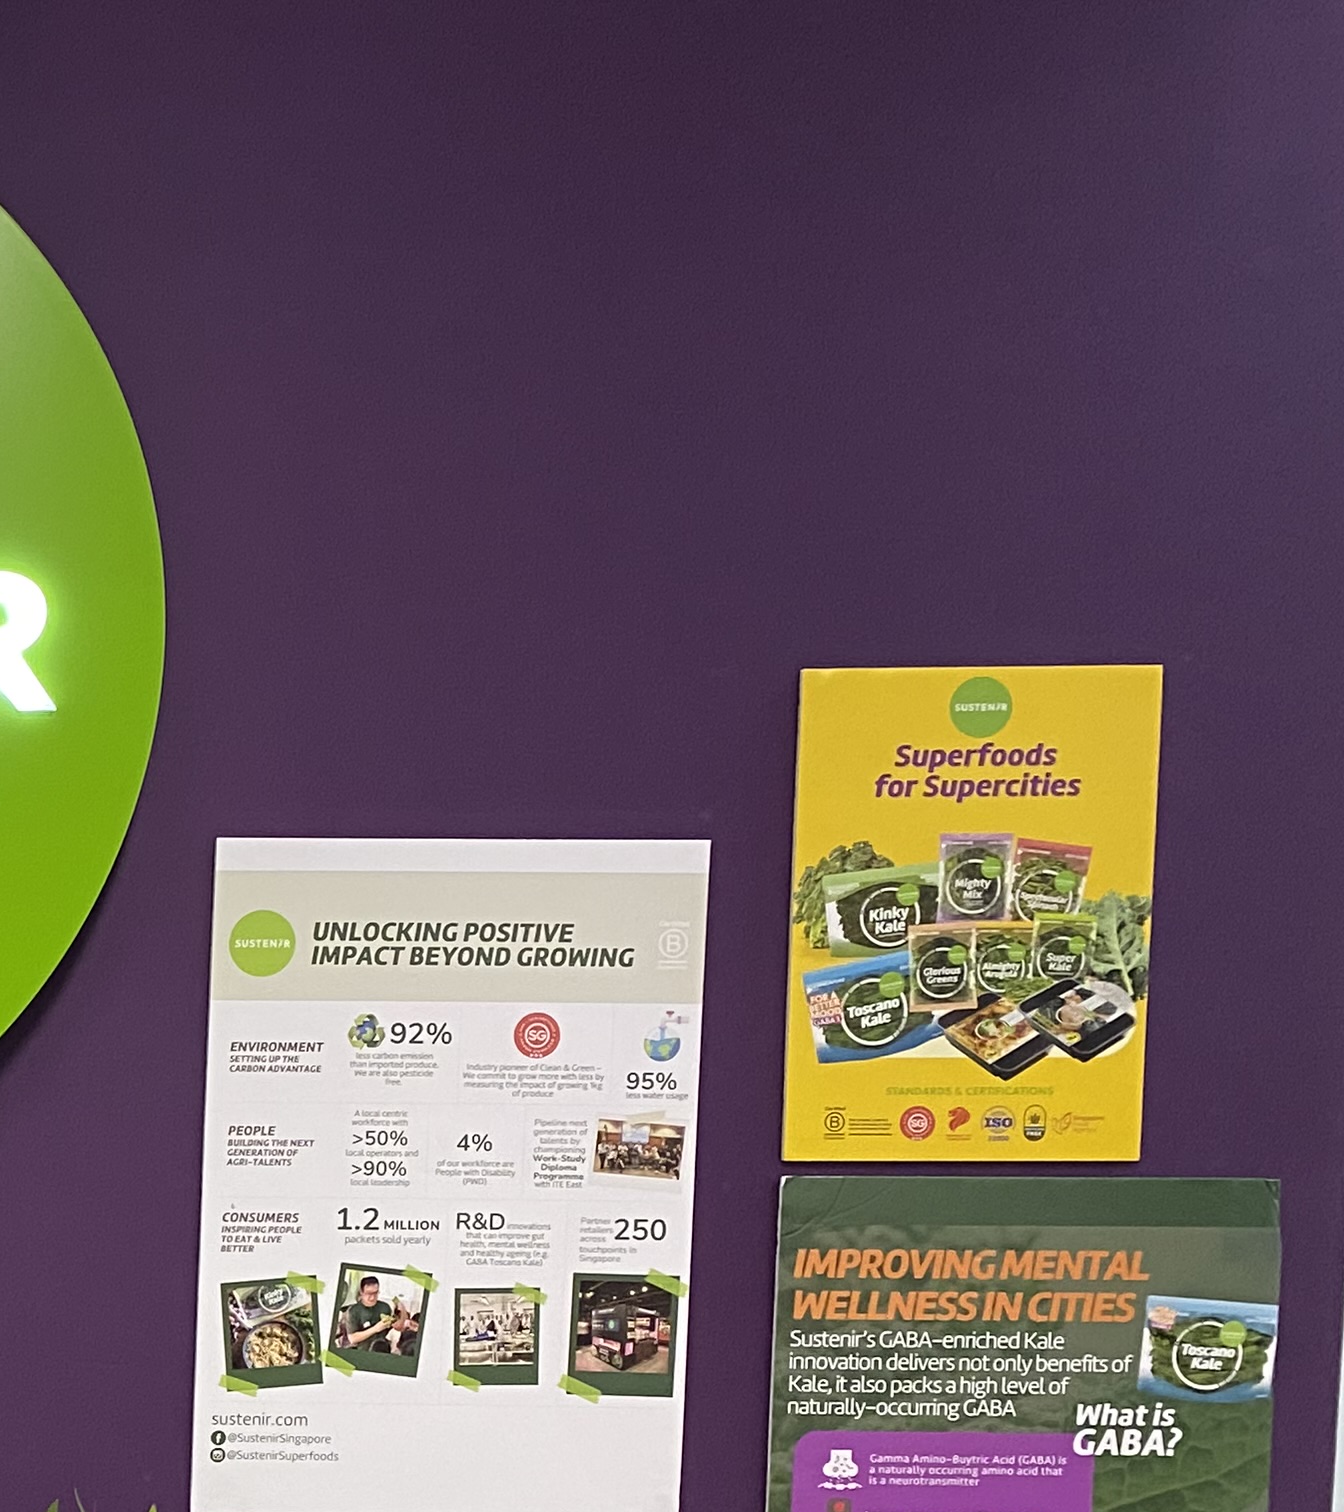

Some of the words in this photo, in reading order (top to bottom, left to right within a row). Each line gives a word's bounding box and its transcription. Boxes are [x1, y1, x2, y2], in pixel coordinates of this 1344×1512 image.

[954, 702, 1009, 713] SUSTENIR
[894, 742, 1059, 772] Superfoods
[874, 774, 918, 798] for
[922, 774, 1083, 803] Supercities
[868, 904, 910, 923] Kinky
[312, 921, 460, 944] UNLOCKING
[463, 922, 576, 944] POSITIVE
[874, 920, 907, 935] Kale
[233, 937, 292, 949] SUSTENIR
[311, 945, 407, 967] IMPACT
[409, 945, 512, 967] BEYOND
[516, 946, 636, 969] GROWING
[846, 997, 901, 1019] Toscano
[860, 1011, 892, 1029] Kale
[389, 1022, 453, 1046] 92%
[229, 1041, 325, 1053] ENVIRONMENT
[625, 1071, 678, 1091] 95%
[227, 1125, 277, 1137] PEOPLE
[352, 1130, 408, 1147] >50%
[456, 1133, 493, 1152] 4%
[351, 1160, 408, 1177] >90%
[221, 1212, 300, 1224] CONSUMERS
[336, 1206, 381, 1231] 1.2
[383, 1219, 440, 1231] MILLION
[455, 1212, 506, 1231] R&D
[614, 1218, 667, 1242] 250
[791, 1248, 1002, 1281] IMPROVING
[999, 1249, 1150, 1282] MENTAL
[790, 1289, 983, 1323] WELLNESS
[981, 1291, 1025, 1322] IN
[1027, 1291, 1138, 1323] CITIES
[788, 1329, 877, 1351] Sustenir's
[878, 1330, 1021, 1351] GABA-enriched
[1024, 1331, 1065, 1350] Kale
[788, 1352, 882, 1373] innovation
[885, 1353, 955, 1373] delivers
[958, 1356, 989, 1373] not
[992, 1353, 1033, 1378] only
[1034, 1353, 1109, 1373] benefits
[1111, 1354, 1134, 1373] of
[787, 1376, 833, 1396] Kale,
[835, 1376, 848, 1395] it
[850, 1376, 888, 1395] also
[890, 1376, 943, 1399] packs
[945, 1380, 956, 1395] a
[958, 1376, 999, 1400] high
[1001, 1377, 1045, 1396] level
[1047, 1377, 1071, 1395] of
[210, 1411, 310, 1429] sustenir.com
[787, 1398, 960, 1421] naturally-occurring
[963, 1399, 1017, 1417] GABA
[1074, 1403, 1146, 1428] What
[1150, 1403, 1176, 1428] is
[226, 1431, 333, 1447] @SustenirSingapore
[1072, 1428, 1184, 1457] GABA?
[226, 1447, 340, 1464] @SustenirSuperfoods
